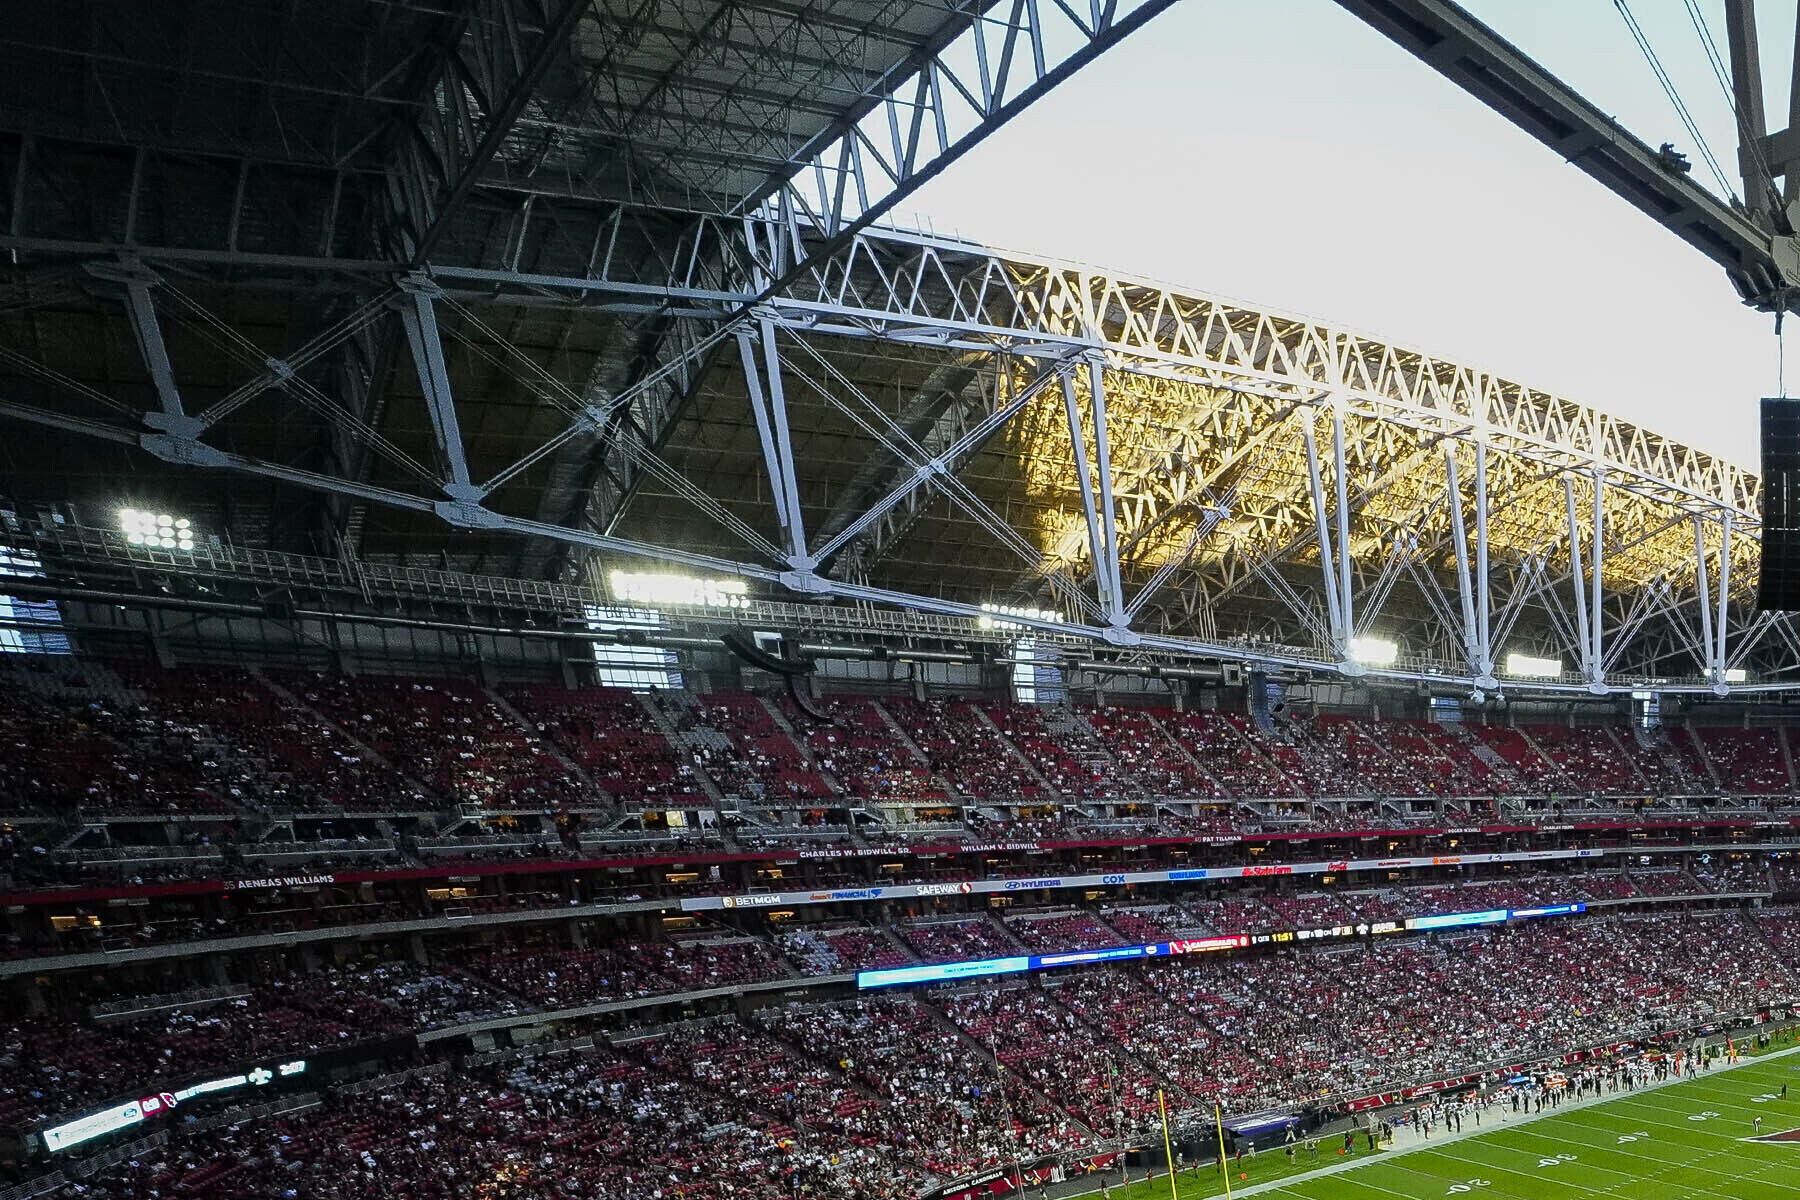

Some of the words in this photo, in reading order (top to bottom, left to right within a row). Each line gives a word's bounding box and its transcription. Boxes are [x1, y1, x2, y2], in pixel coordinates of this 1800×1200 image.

[960, 843, 996, 852] WILLIAM
[1007, 842, 1040, 851] BIDWILL
[799, 849, 842, 858] CHARLES
[844, 849, 856, 857] W.
[238, 878, 282, 889] AENEAS
[283, 874, 335, 886] WILLIAMS
[1021, 880, 1062, 888] HYUNDAI
[1103, 875, 1126, 884] COX
[916, 884, 959, 896] SAFEWAY
[735, 896, 781, 906] BETMGM
[1619, 1131, 1649, 1145] 40
[1539, 1153, 1578, 1168] 30
[943, 1183, 970, 1196] ARIZONA
[1450, 1178, 1492, 1195] 20
